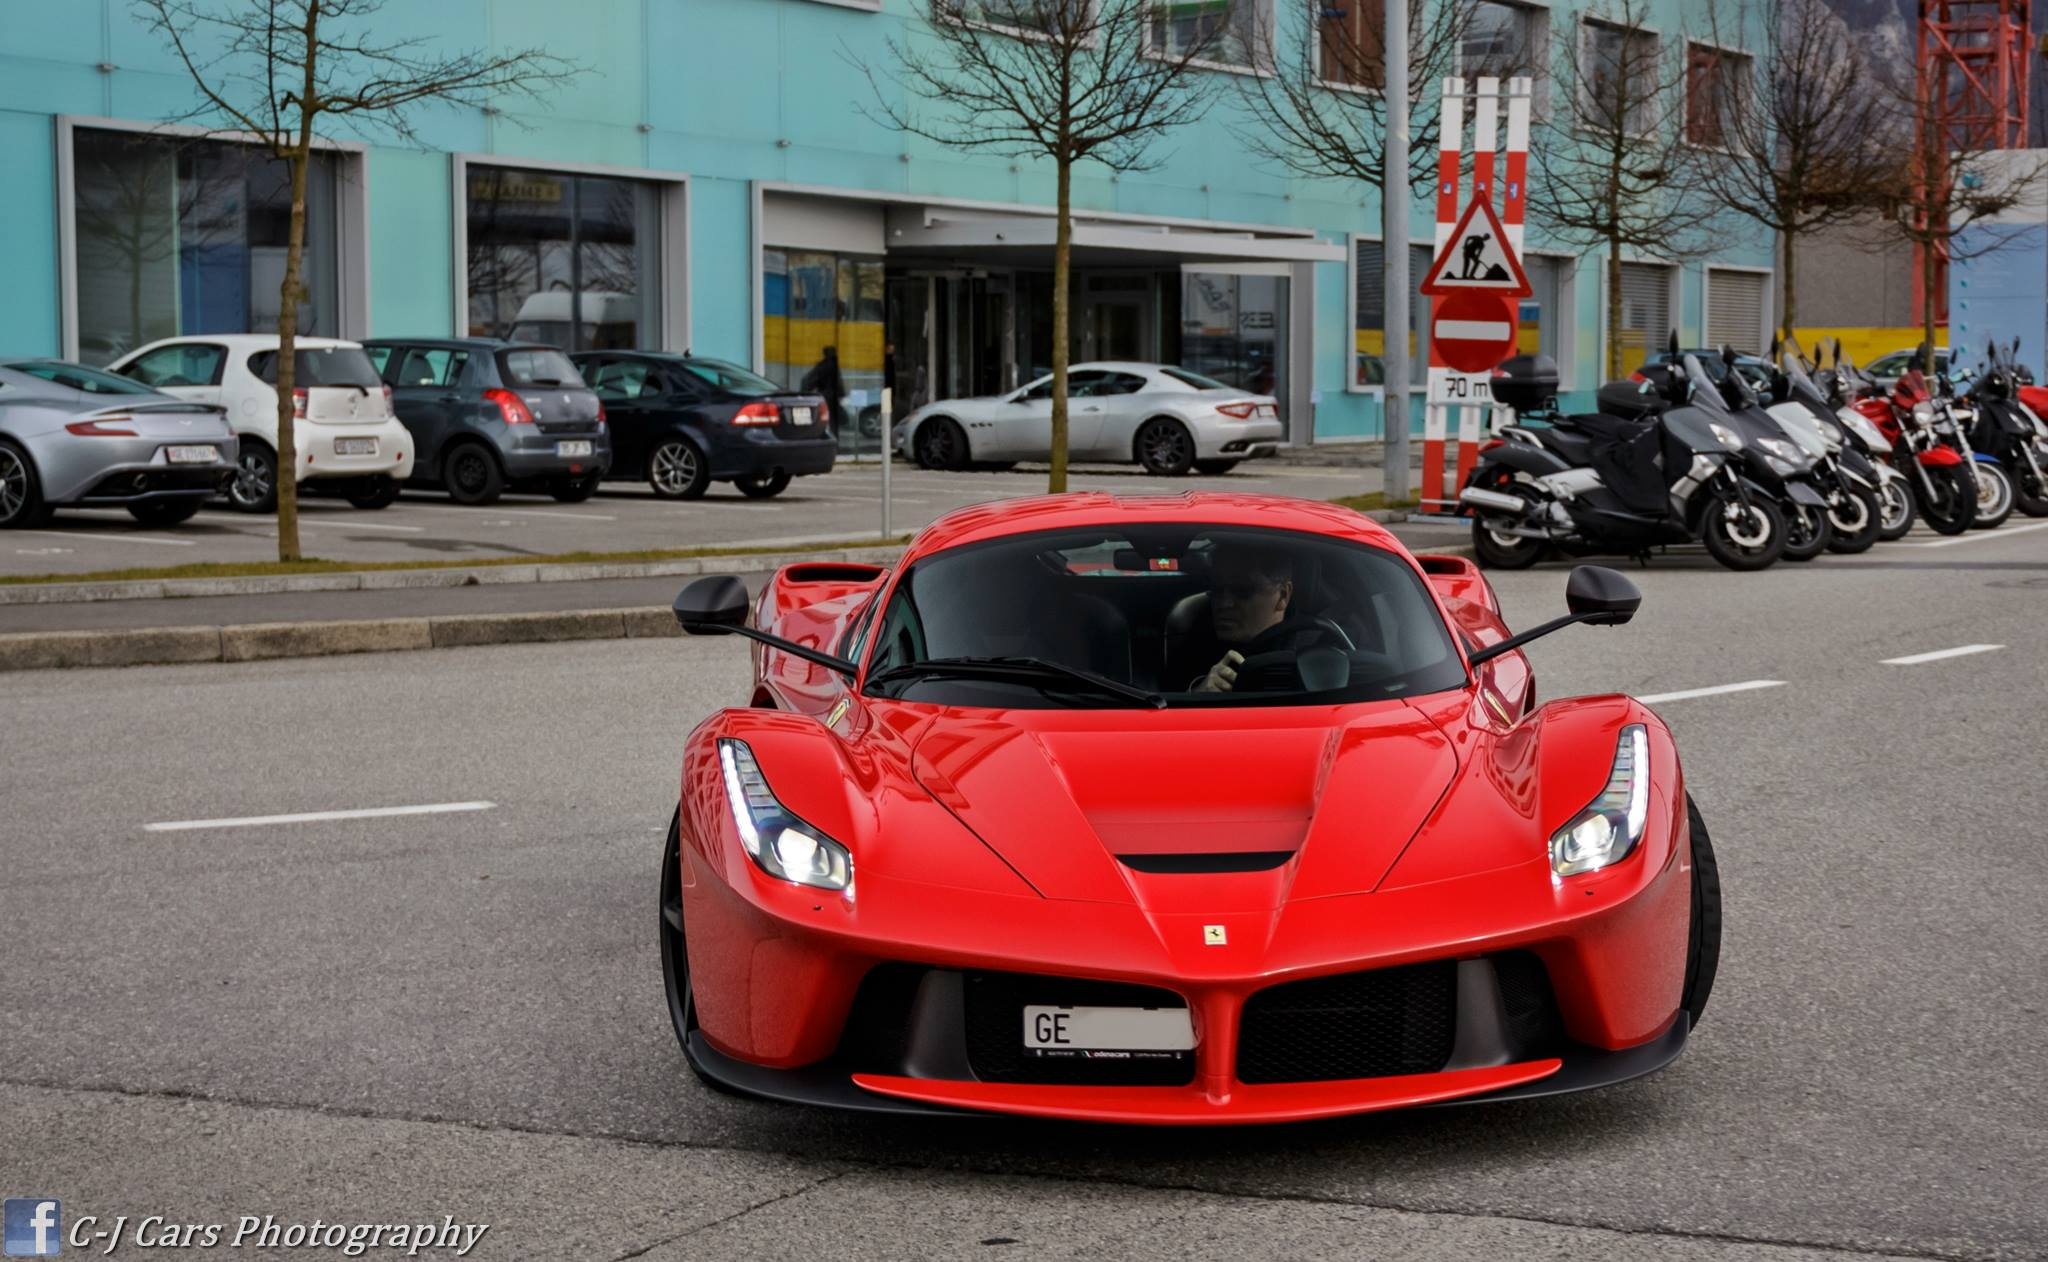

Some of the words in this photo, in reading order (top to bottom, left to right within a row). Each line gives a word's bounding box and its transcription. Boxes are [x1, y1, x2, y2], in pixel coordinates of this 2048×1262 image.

[1445, 377, 1467, 398] 70
[1473, 382, 1488, 397] m
[1035, 1013, 1071, 1044] GE
